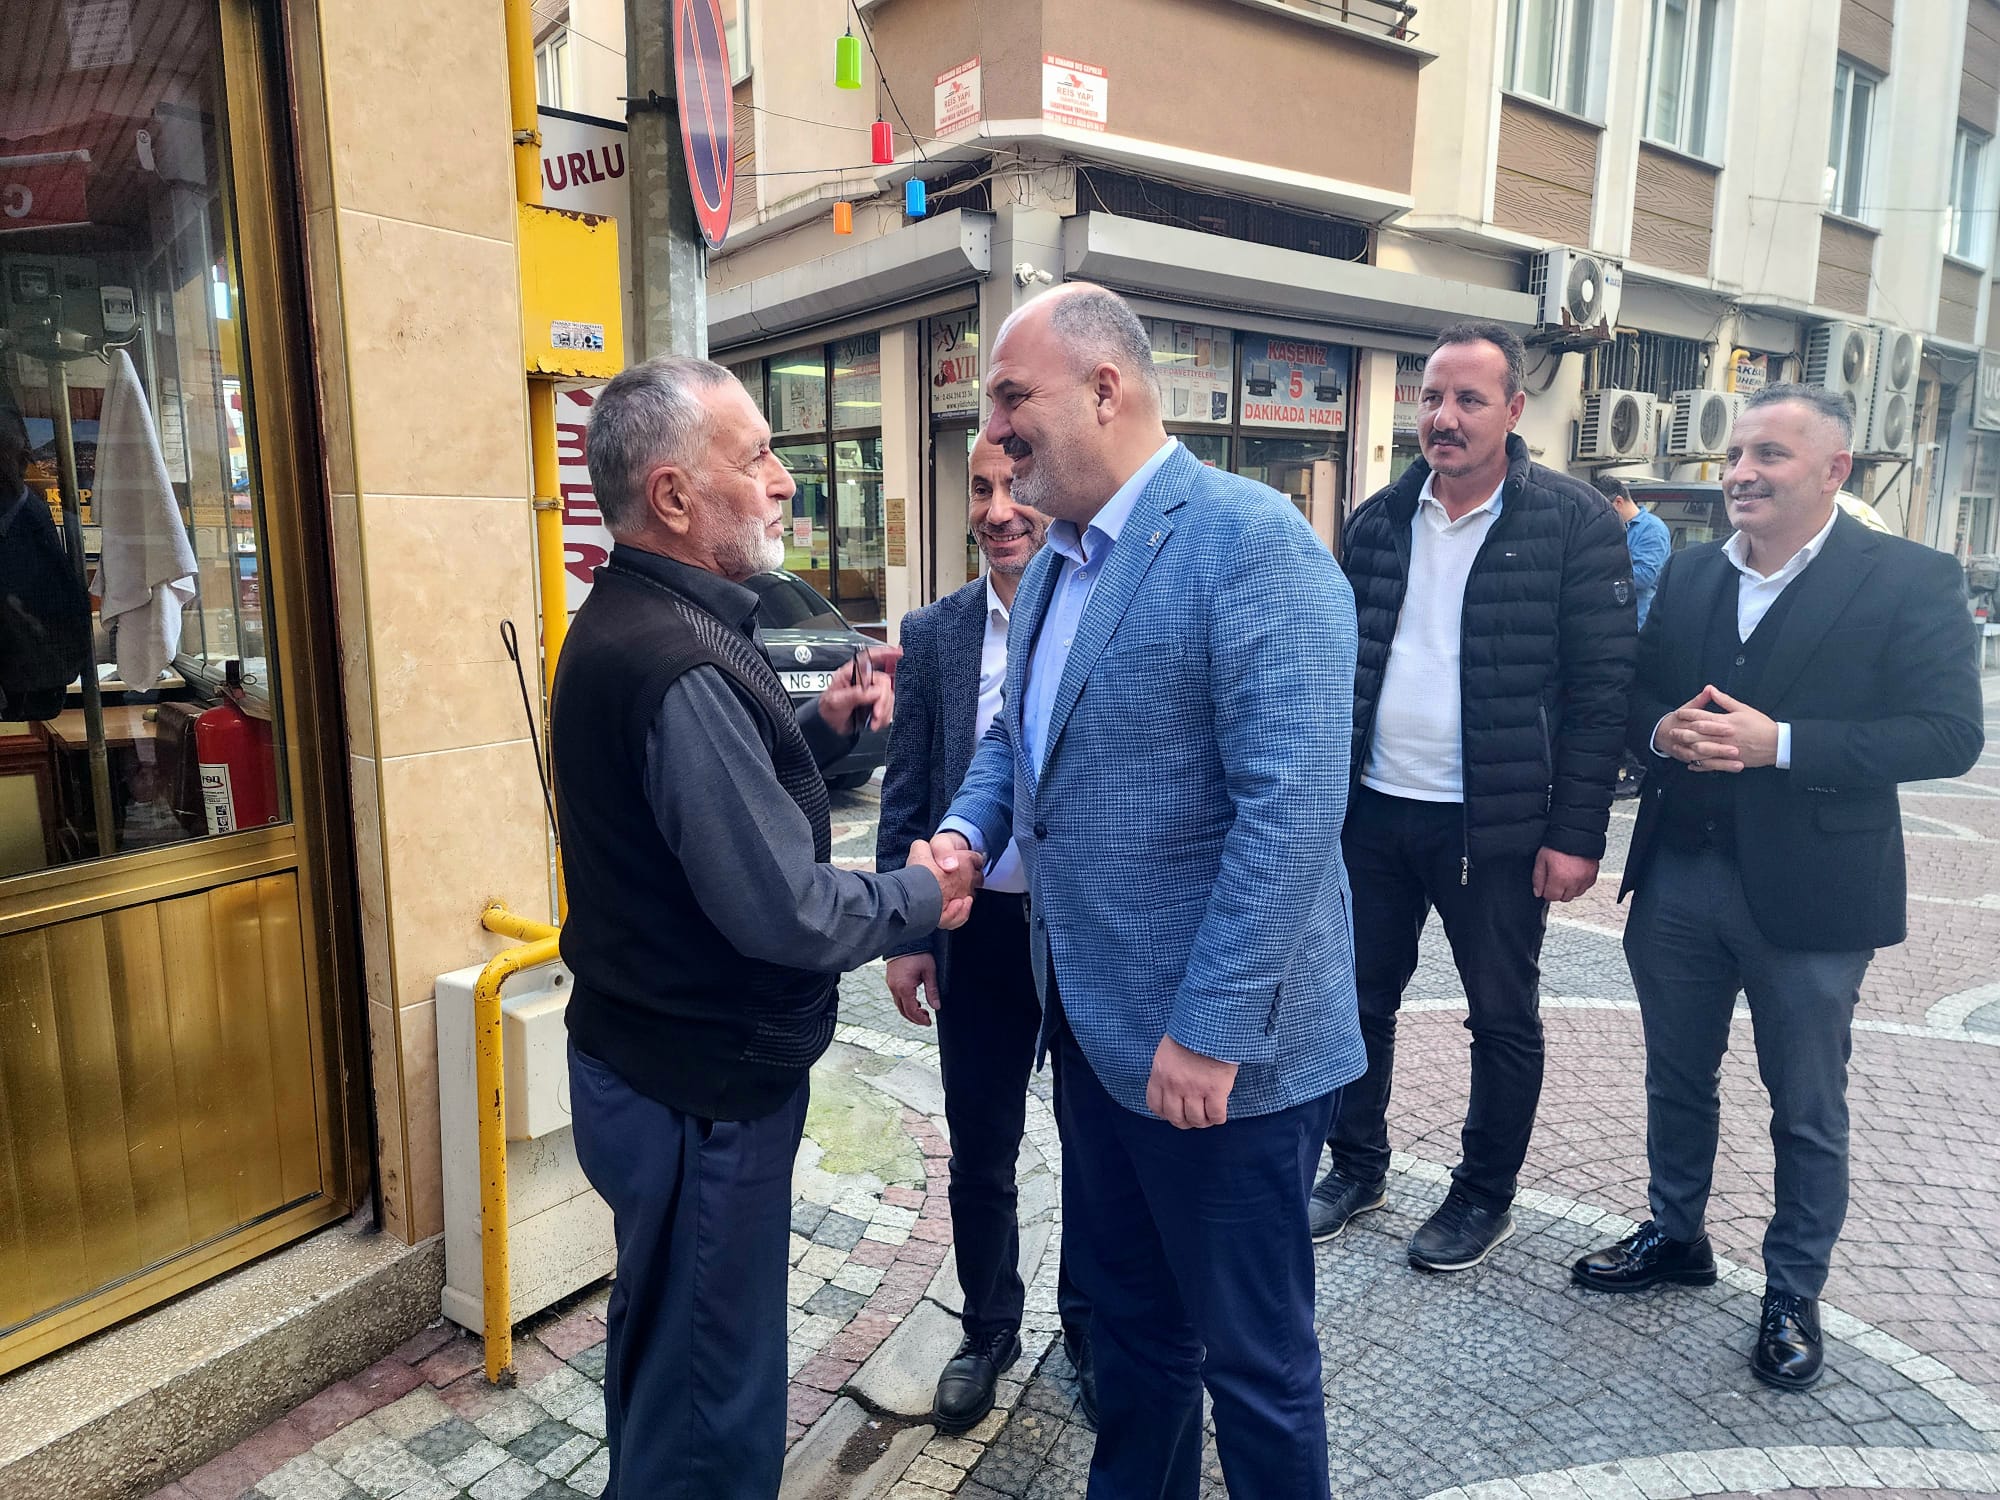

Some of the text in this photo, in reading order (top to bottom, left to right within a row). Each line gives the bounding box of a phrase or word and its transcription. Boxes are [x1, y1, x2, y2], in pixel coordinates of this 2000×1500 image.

[541, 143, 625, 191] URLU
[1268, 340, 1328, 368] KAŞENİZ
[1289, 371, 1304, 399] 5
[1244, 400, 1343, 426] DAKİKADA HAZIR
[789, 673, 811, 689] NG
